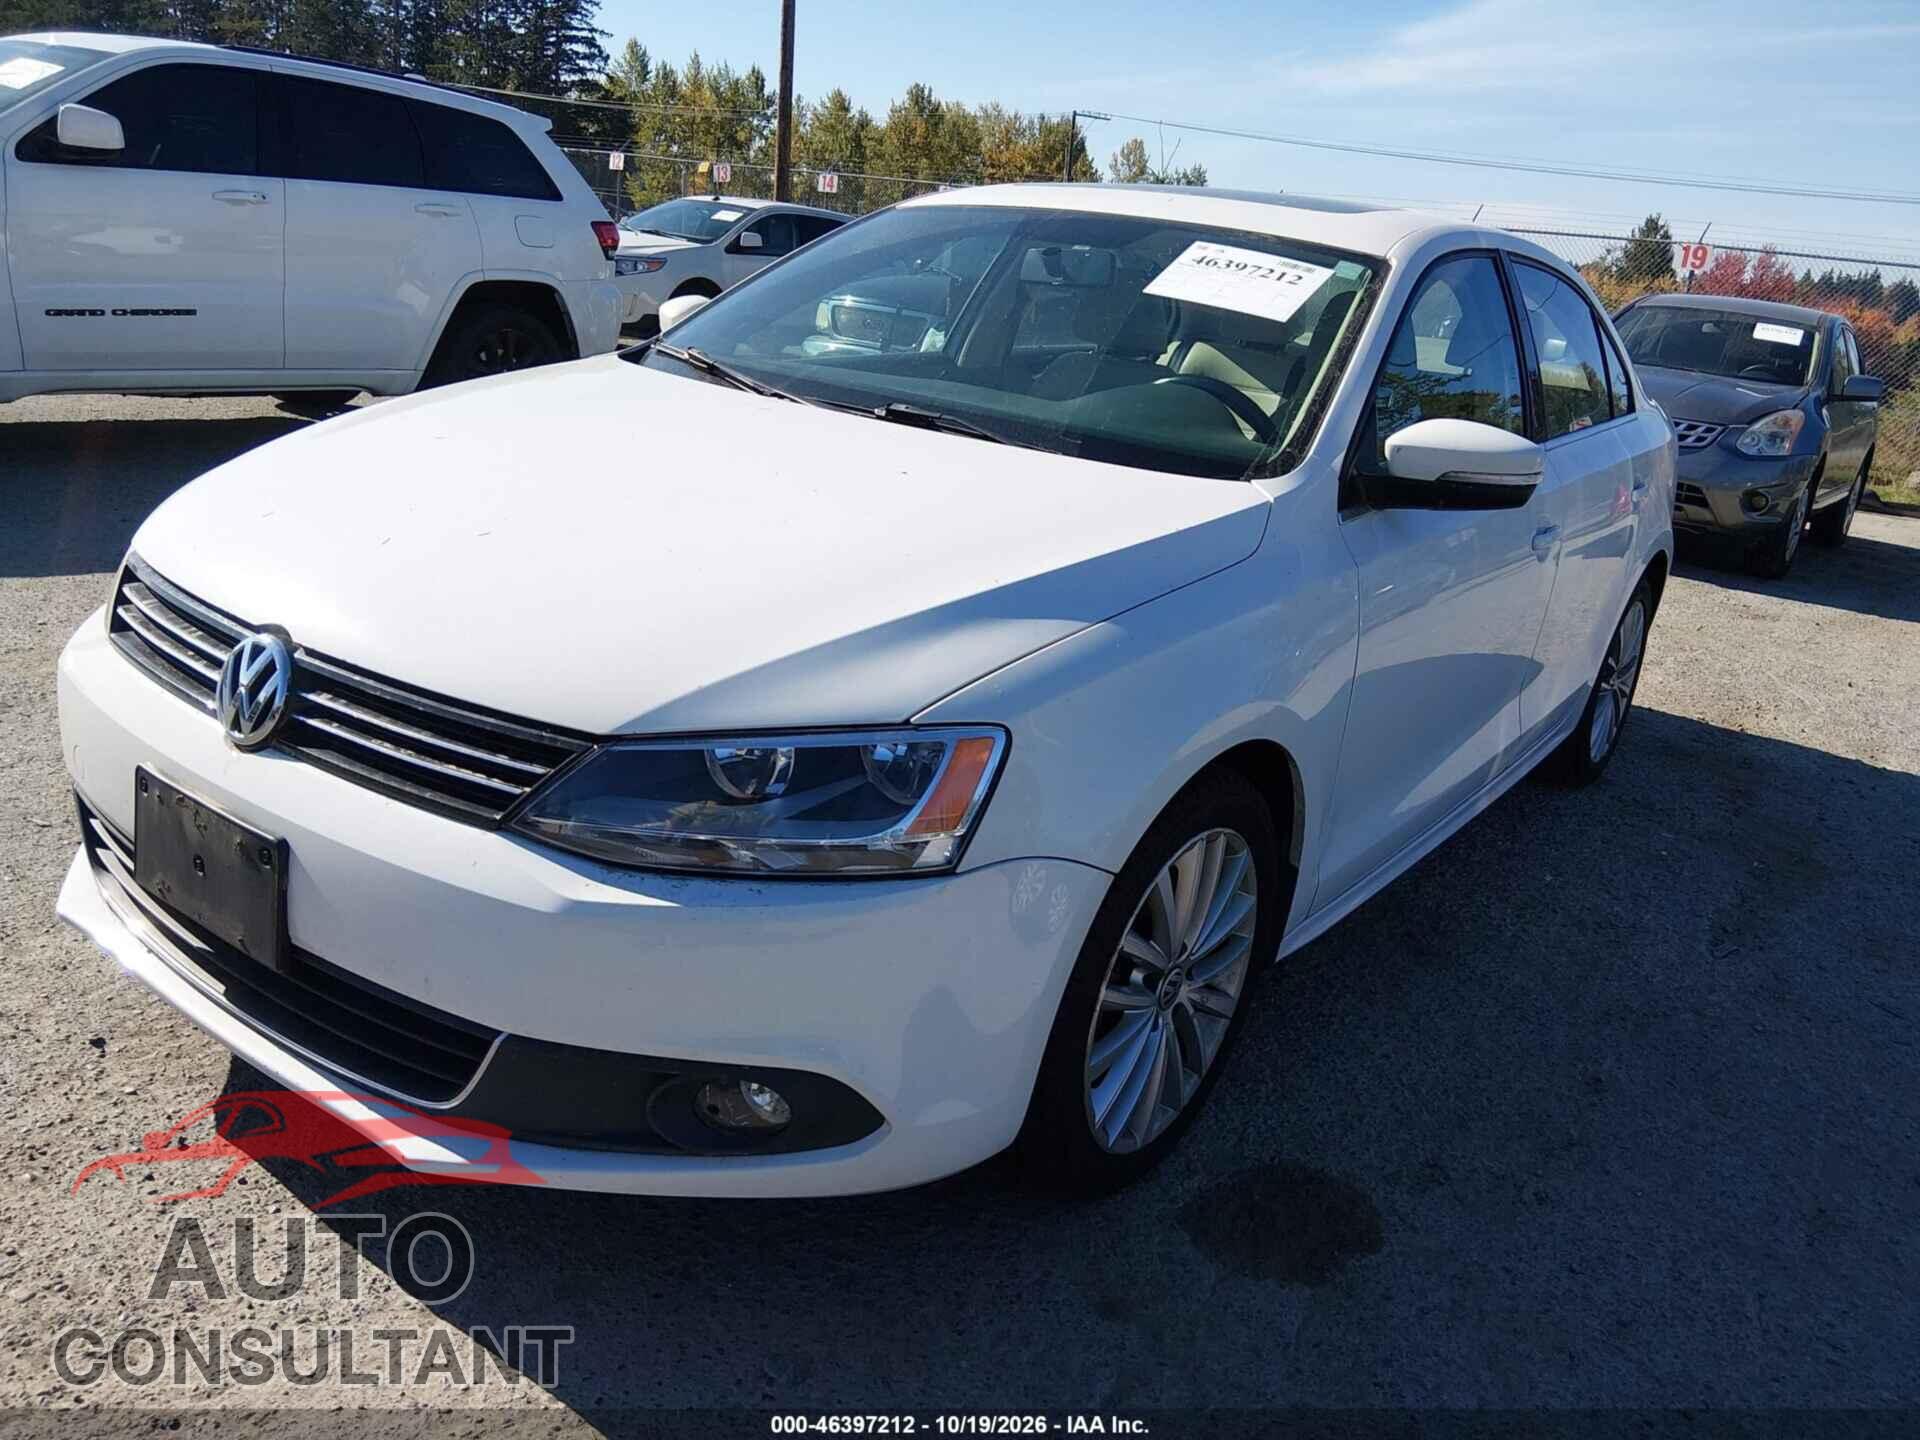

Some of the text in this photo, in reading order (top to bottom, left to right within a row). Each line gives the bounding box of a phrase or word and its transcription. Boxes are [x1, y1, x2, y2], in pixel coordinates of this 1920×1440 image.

[612, 154, 622, 169] 12
[716, 165, 729, 181] 13
[822, 175, 835, 191] 14
[1681, 244, 1708, 269] 19
[1192, 255, 1304, 286] 46397212
[44, 308, 106, 317] GRAND
